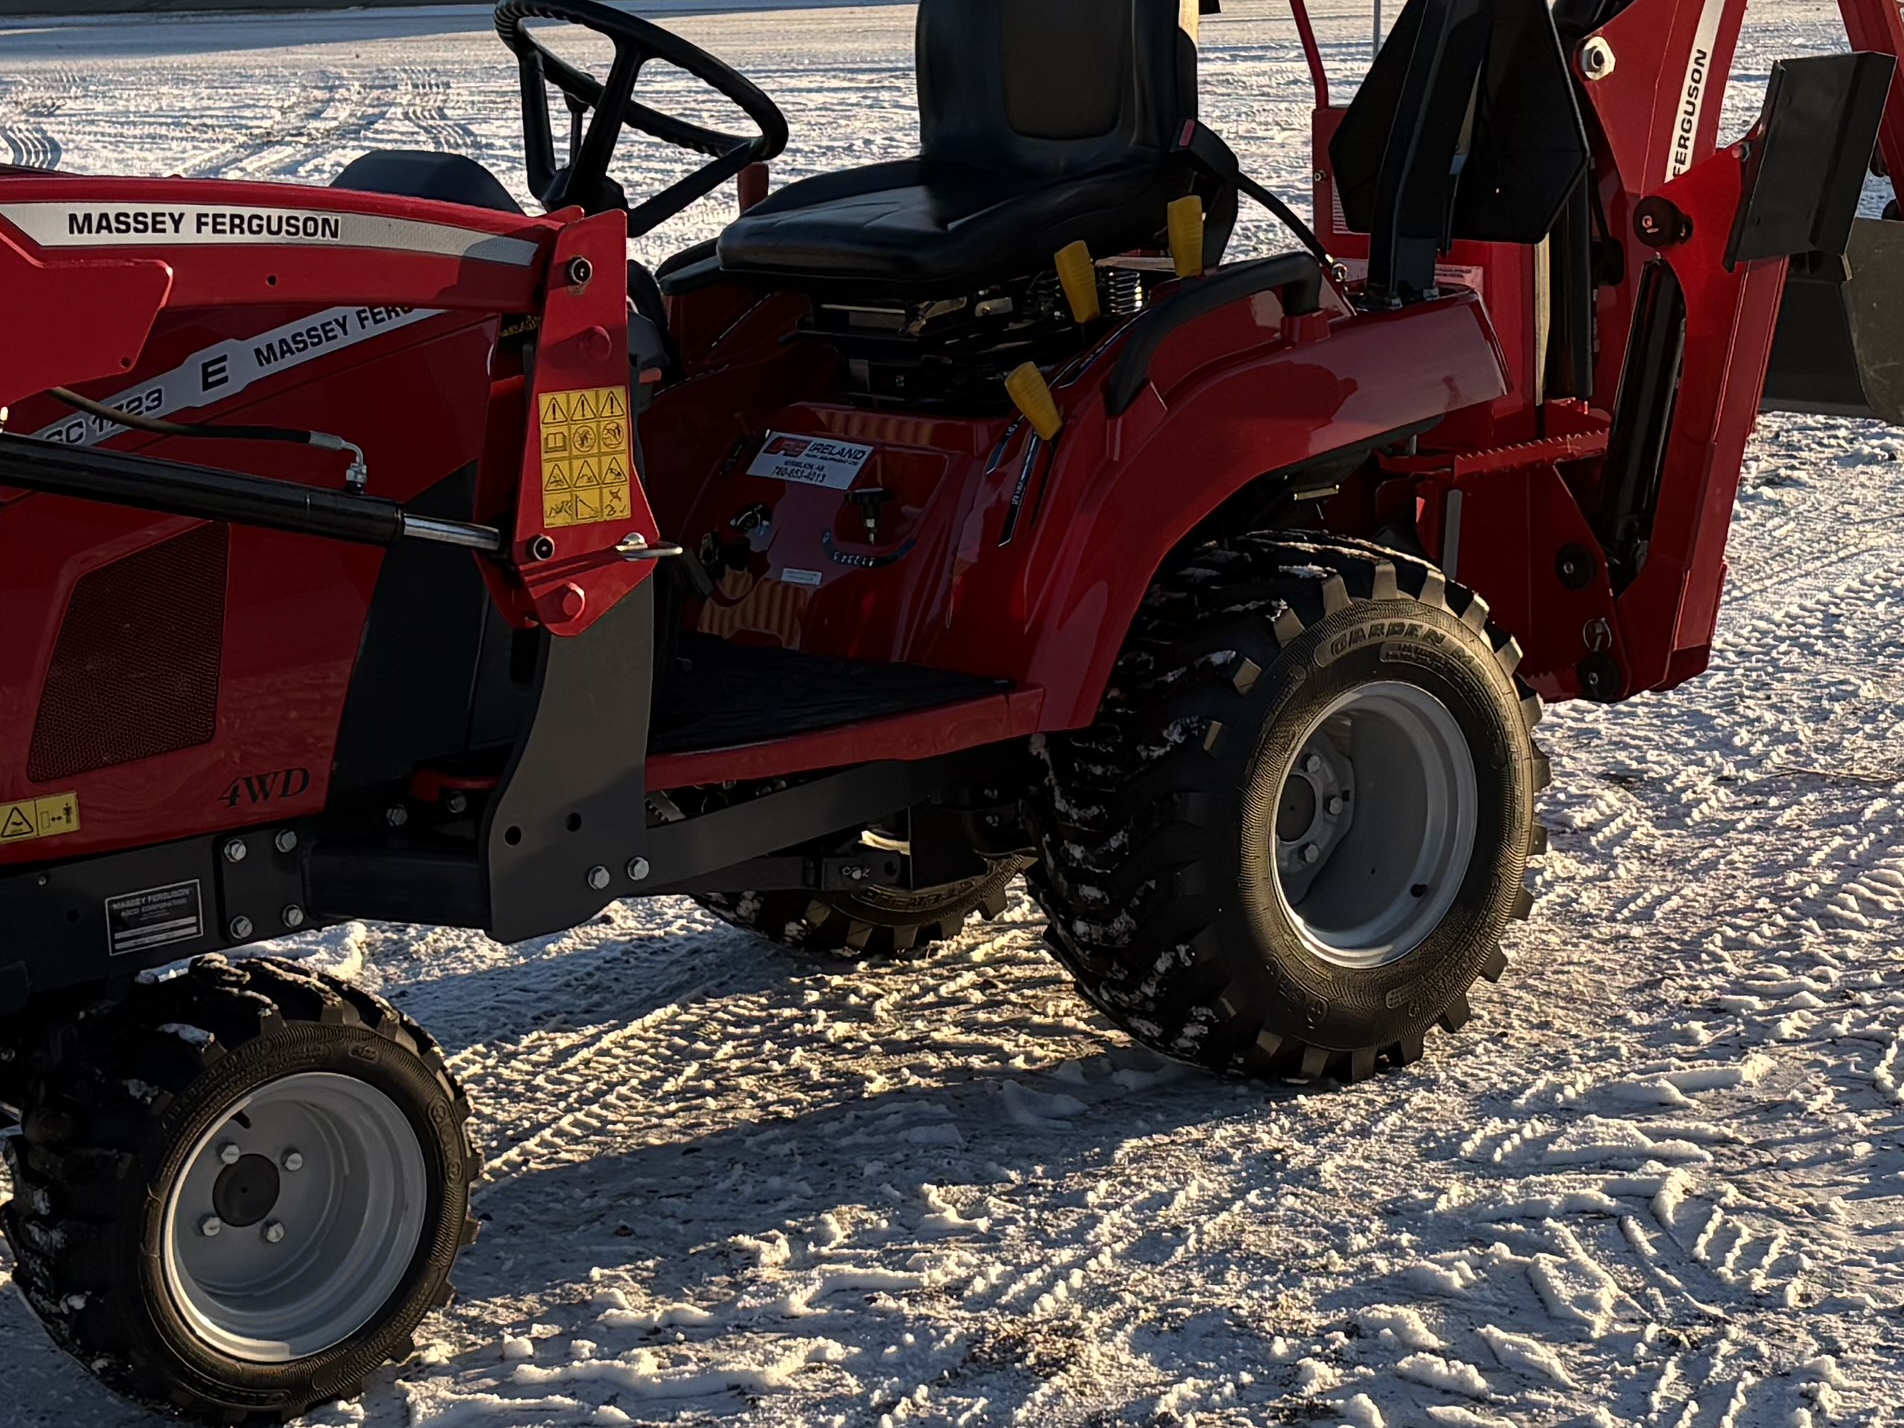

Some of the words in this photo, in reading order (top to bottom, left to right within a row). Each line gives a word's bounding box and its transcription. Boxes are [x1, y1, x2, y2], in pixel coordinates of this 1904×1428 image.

[1672, 49, 1707, 178] FERGUSON
[68, 212, 185, 235] MASSEY
[196, 213, 339, 239] FERGUSON
[201, 354, 229, 392] E
[253, 315, 349, 368] MASSEY
[808, 442, 867, 461] IRELAND
[218, 768, 310, 808] 4WD
